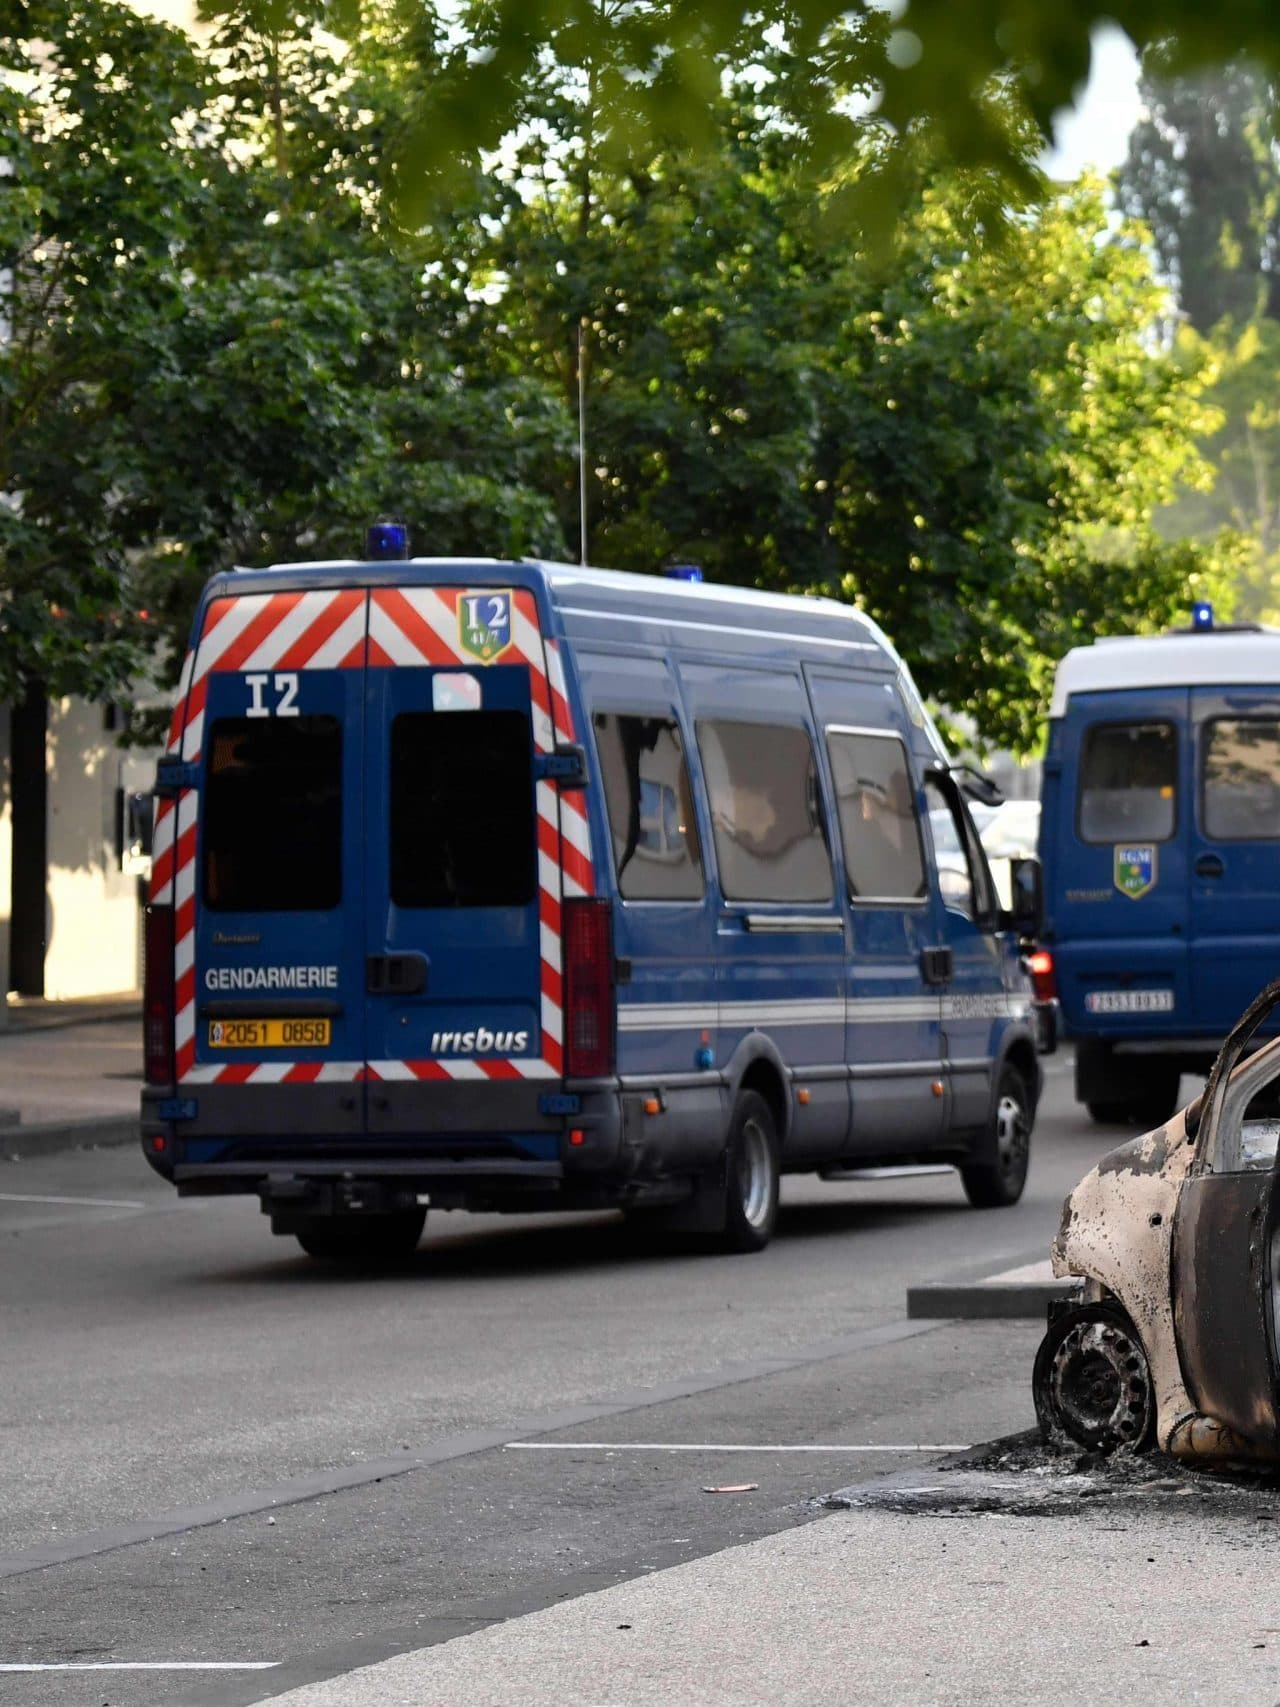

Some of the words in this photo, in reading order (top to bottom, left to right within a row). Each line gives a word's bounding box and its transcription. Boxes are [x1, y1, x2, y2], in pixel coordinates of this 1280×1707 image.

[205, 966, 338, 990] GENDARMERIE
[226, 1023, 268, 1043] 2051
[282, 1022, 326, 1043] 0858
[431, 1027, 528, 1053] irisbus
